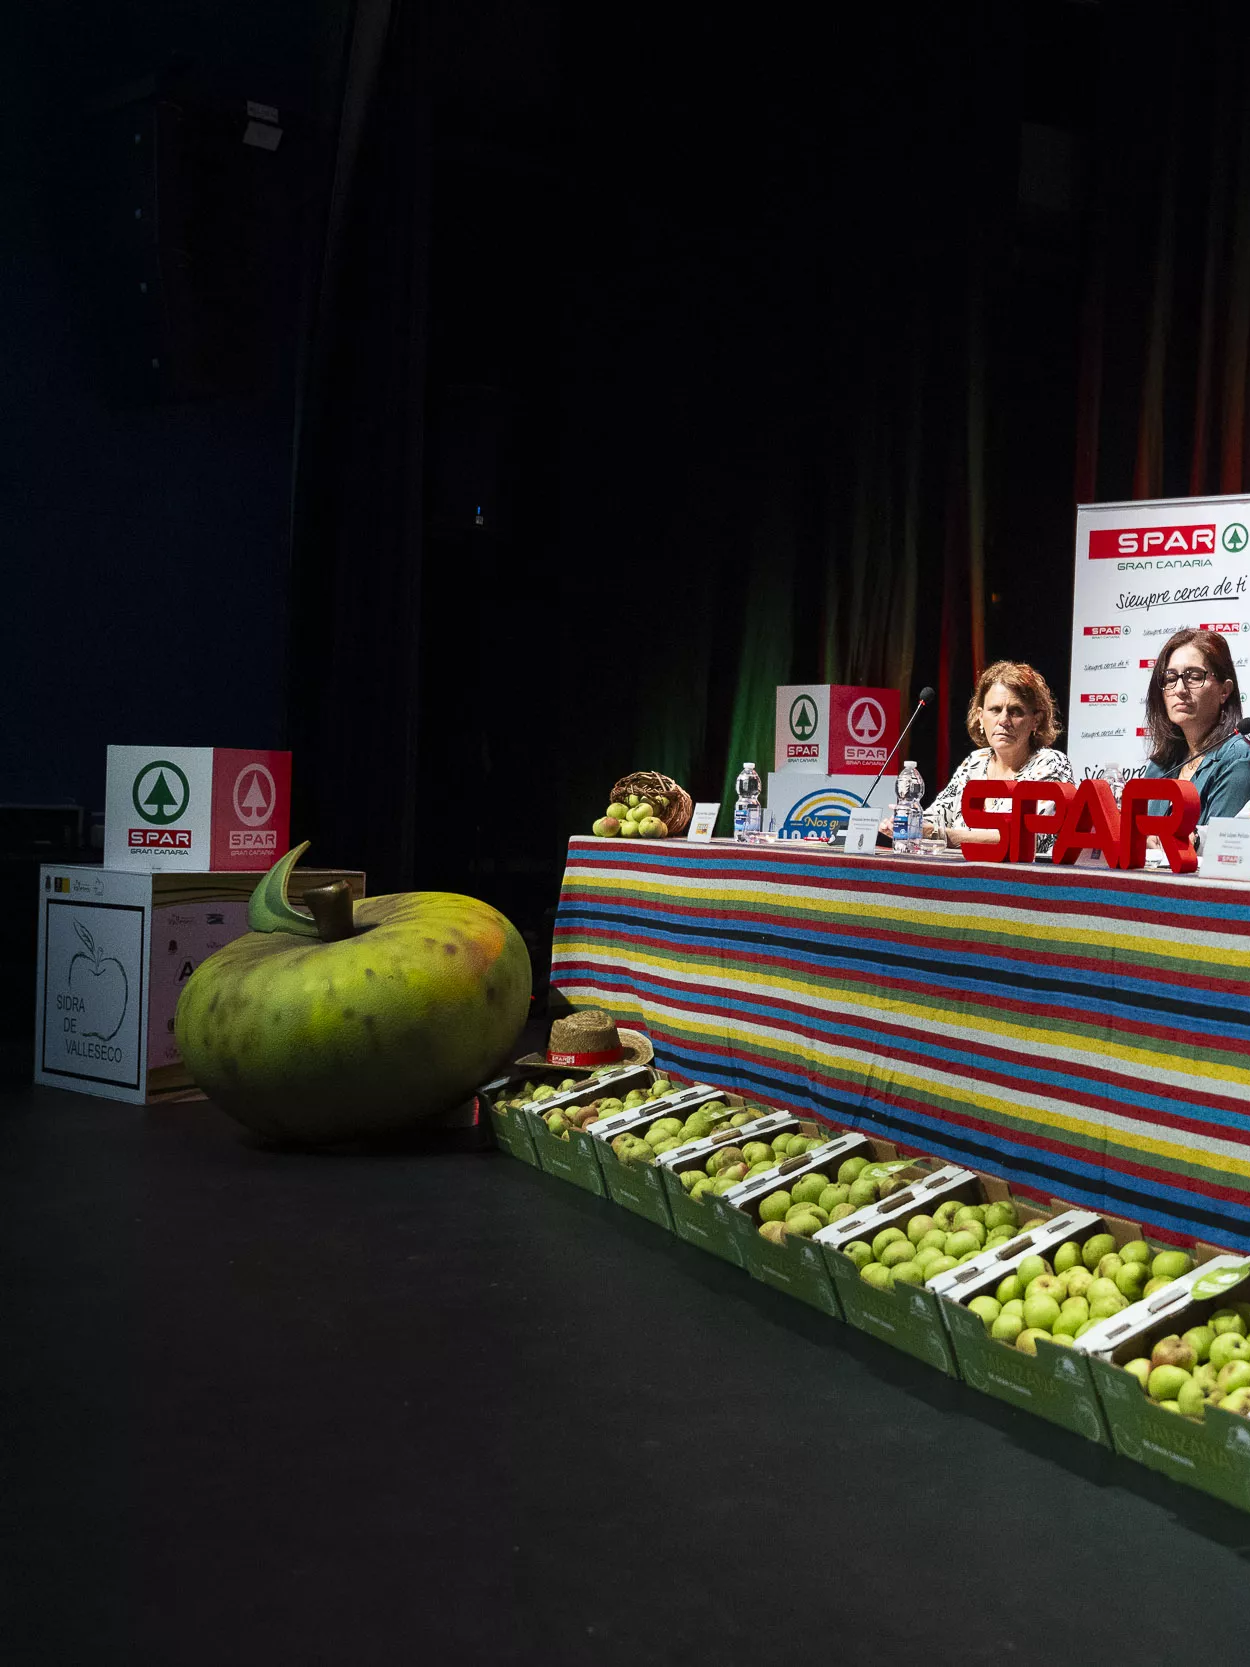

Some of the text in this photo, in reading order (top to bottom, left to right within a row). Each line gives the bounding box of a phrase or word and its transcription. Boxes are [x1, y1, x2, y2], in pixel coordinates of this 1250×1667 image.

[1118, 529, 1214, 554] SPAR
[1117, 559, 1213, 571] GRAN CANARIA
[1173, 585, 1210, 602] cerca
[1213, 576, 1233, 596] de
[1236, 575, 1248, 593] ti
[1091, 627, 1121, 635] SPAR
[1207, 623, 1240, 632] SPAR
[1088, 694, 1119, 702] SPAR
[788, 746, 818, 756] SPAR
[846, 748, 886, 759] SPAR
[803, 816, 828, 827] Nos
[960, 778, 1201, 873] SPAR
[130, 831, 190, 846] SPAR
[231, 833, 275, 846] SPAR
[154, 848, 189, 856] CANARIA
[56, 994, 86, 1013] SIDRA
[63, 1017, 77, 1033] DE
[65, 1039, 123, 1063] VALLESECO
